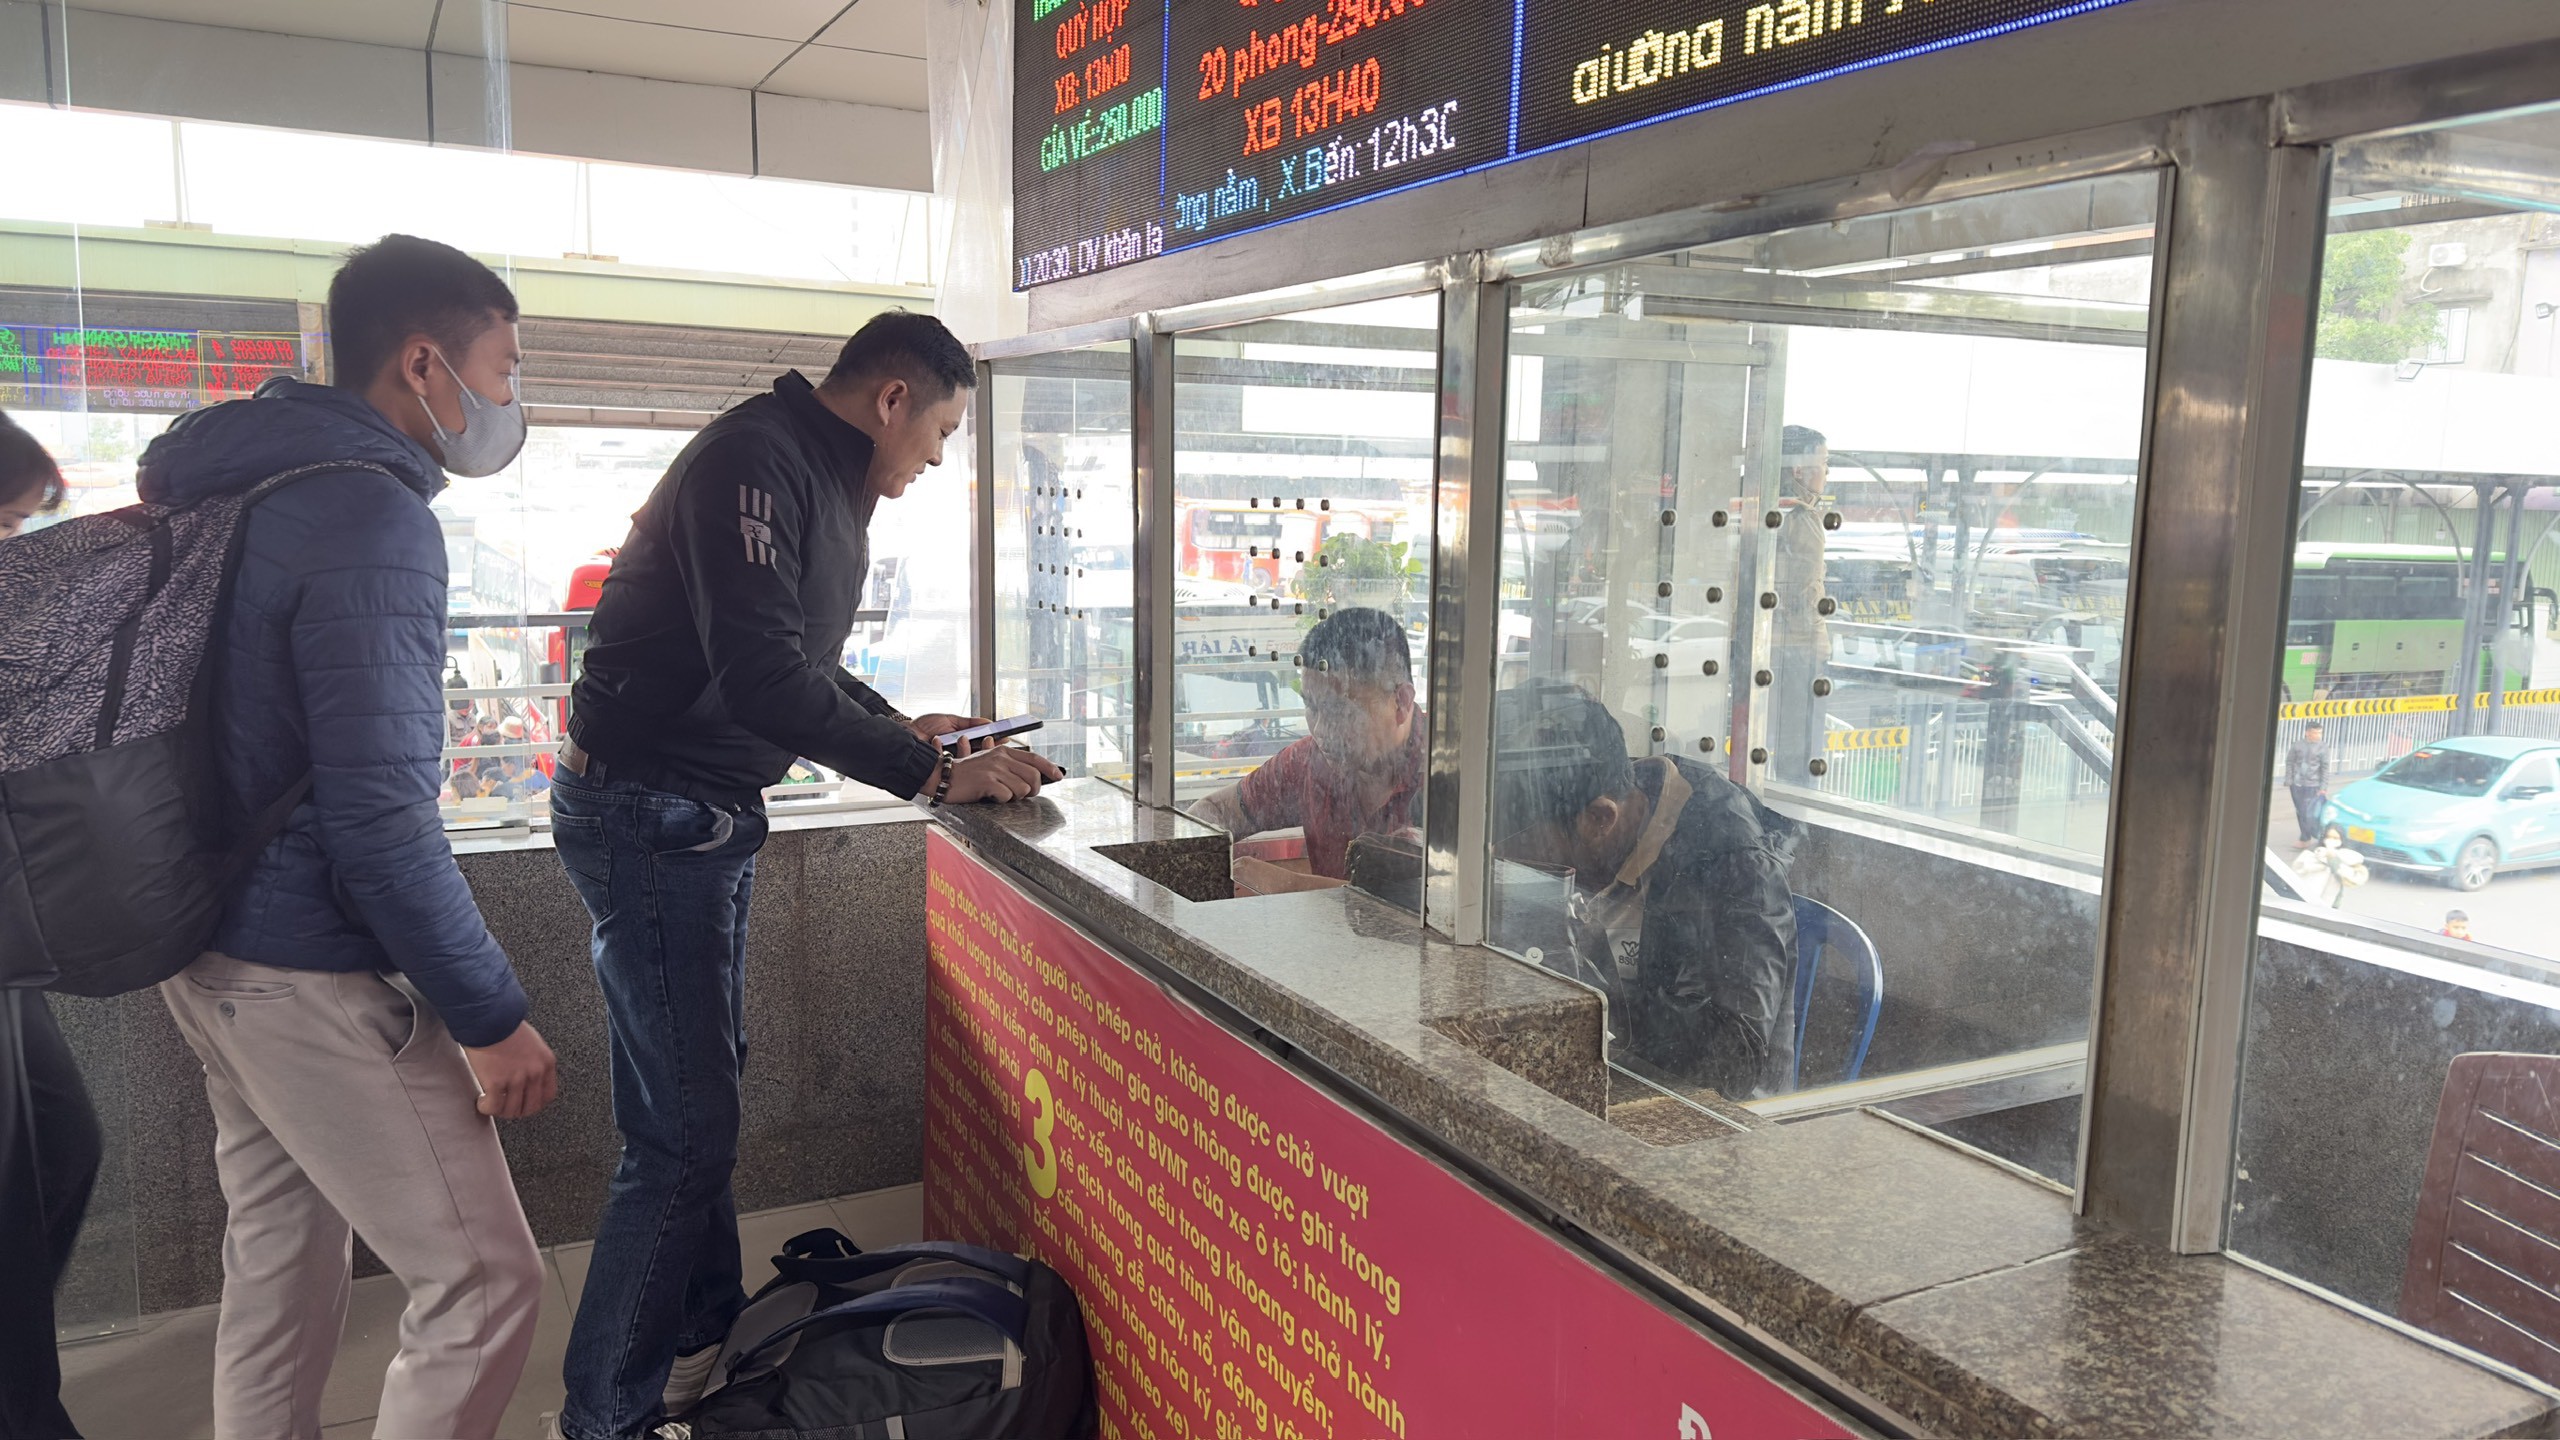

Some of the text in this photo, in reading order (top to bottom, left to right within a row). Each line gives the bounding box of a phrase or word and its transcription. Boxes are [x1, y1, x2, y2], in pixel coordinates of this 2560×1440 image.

[1055, 71, 1080, 114] XB:
[1198, 46, 1227, 100] 20
[1243, 57, 1380, 156] XB 13H40
[929, 909, 1400, 1315] quá khối lượng toàn bộ cho phép tham gia giao thông được ghi trong
[931, 868, 1369, 1221] Không được chở quá số người cho phép chở, không được chở vượt
[931, 941, 948, 975] Giấy
[951, 961, 976, 1003] chứng
[979, 988, 1000, 1021] nhận
[1003, 1006, 1026, 1045] kiểm
[1029, 1033, 1052, 1069] định
[1056, 1055, 1069, 1082] AT
[1089, 1081, 1123, 1132] thuật
[1127, 1118, 1143, 1149] và
[1149, 1131, 1188, 1187] BVMT
[1193, 1175, 1223, 1220] của
[1229, 1207, 1250, 1241] xe
[1256, 1222, 1267, 1255] ô
[1273, 1237, 1297, 1289] tô;
[1305, 1263, 1357, 1335] hành
[1365, 1313, 1391, 1370] lý,
[1024, 1068, 1057, 1199] 3
[932, 982, 1405, 1440] hàng hóa ký gửi phải được xếp dàn đều trong khoang chở hành
[941, 1025, 959, 1056] đảm
[962, 1043, 978, 1076] bảo
[981, 1063, 1008, 1114] không
[1011, 1095, 1020, 1129] bị
[1060, 1147, 1074, 1173] xê
[1077, 1163, 1104, 1205] dịch
[1108, 1189, 1142, 1249] trong
[1147, 1234, 1175, 1277] quá
[1180, 1260, 1214, 1316] trình
[1219, 1304, 1250, 1354] vận
[1256, 1343, 1333, 1440] chuyển;
[1003, 1171, 1030, 1217] phẩm
[1035, 1202, 1061, 1246] bẩn.
[1065, 1232, 1083, 1271] Khi
[1088, 1261, 1118, 1311] nhận
[1122, 1295, 1156, 1361] hàng
[1161, 1339, 1189, 1393] hóa
[1194, 1376, 1211, 1421] ký
[1057, 1189, 1087, 1236] cấm,
[1091, 1216, 1123, 1276] hàng
[1128, 1259, 1145, 1293] dễ
[1149, 1285, 1187, 1346] cháy,
[1193, 1329, 1217, 1377] nổ,
[1222, 1361, 1267, 1432] động
[1116, 1340, 1127, 1368] đi
[1131, 1354, 1161, 1408] theo
[1165, 1400, 1189, 1440] xe)
